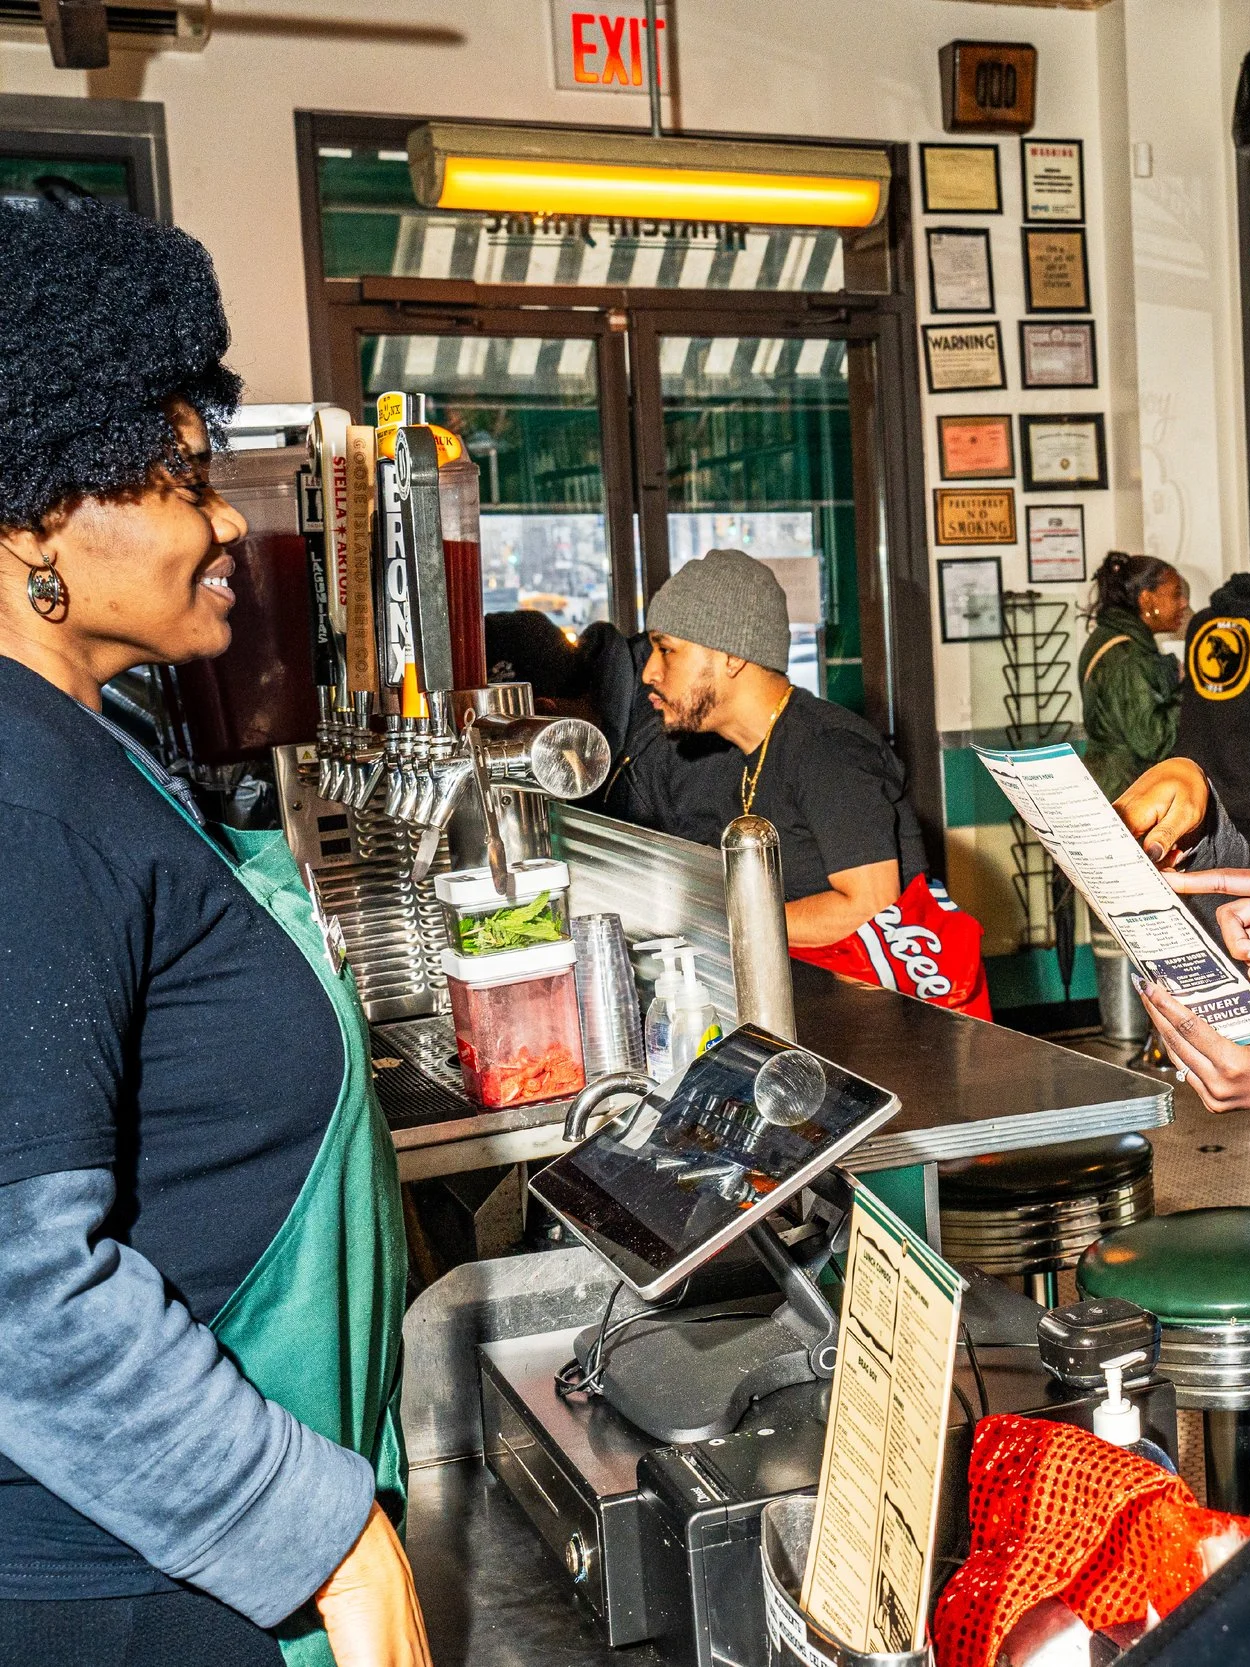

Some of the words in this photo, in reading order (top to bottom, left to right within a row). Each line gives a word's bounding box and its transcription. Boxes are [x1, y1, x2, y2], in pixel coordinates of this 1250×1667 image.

[571, 12, 666, 88] EXIT
[930, 334, 995, 350] WARNING
[333, 456, 347, 520] STELLA
[353, 437, 368, 503] GOOSE
[949, 521, 1008, 535] SMOKING
[967, 510, 987, 519] NO
[336, 541, 347, 606] ARTOIS
[353, 511, 369, 584] ISLAND
[310, 551, 328, 644] LAGUNITAS
[354, 591, 369, 643] BEER
[1191, 996, 1240, 1014] ELIVERY
